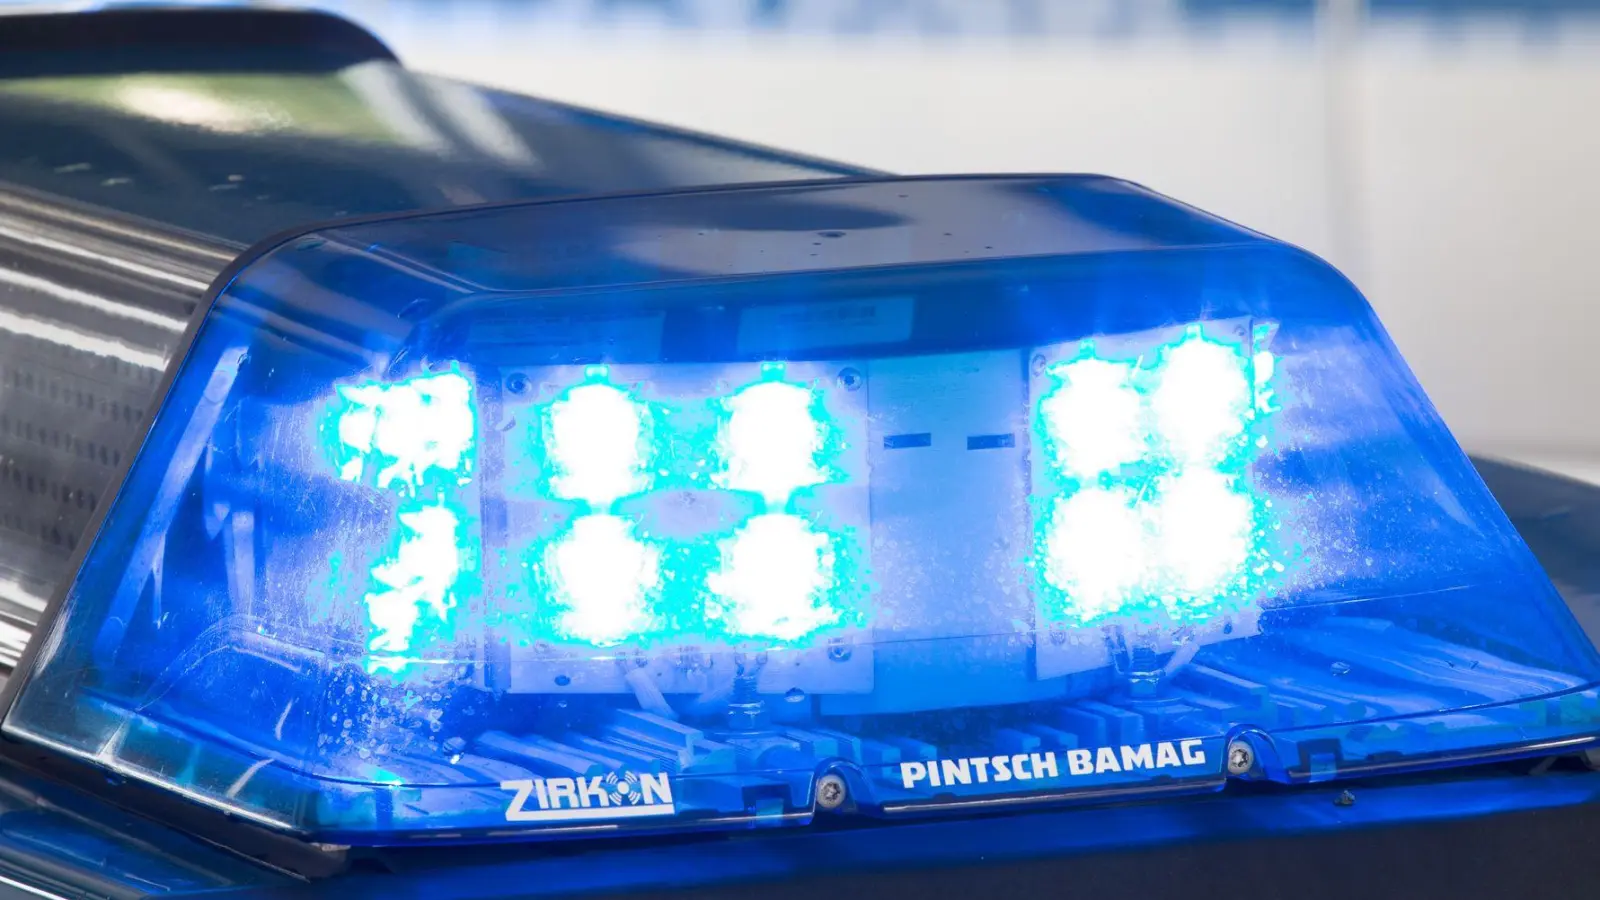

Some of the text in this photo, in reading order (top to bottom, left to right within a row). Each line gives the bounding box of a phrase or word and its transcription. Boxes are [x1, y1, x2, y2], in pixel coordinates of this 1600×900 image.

[900, 739, 1206, 788] PINTSCH BAMAG
[500, 771, 675, 821] ZIRKON
